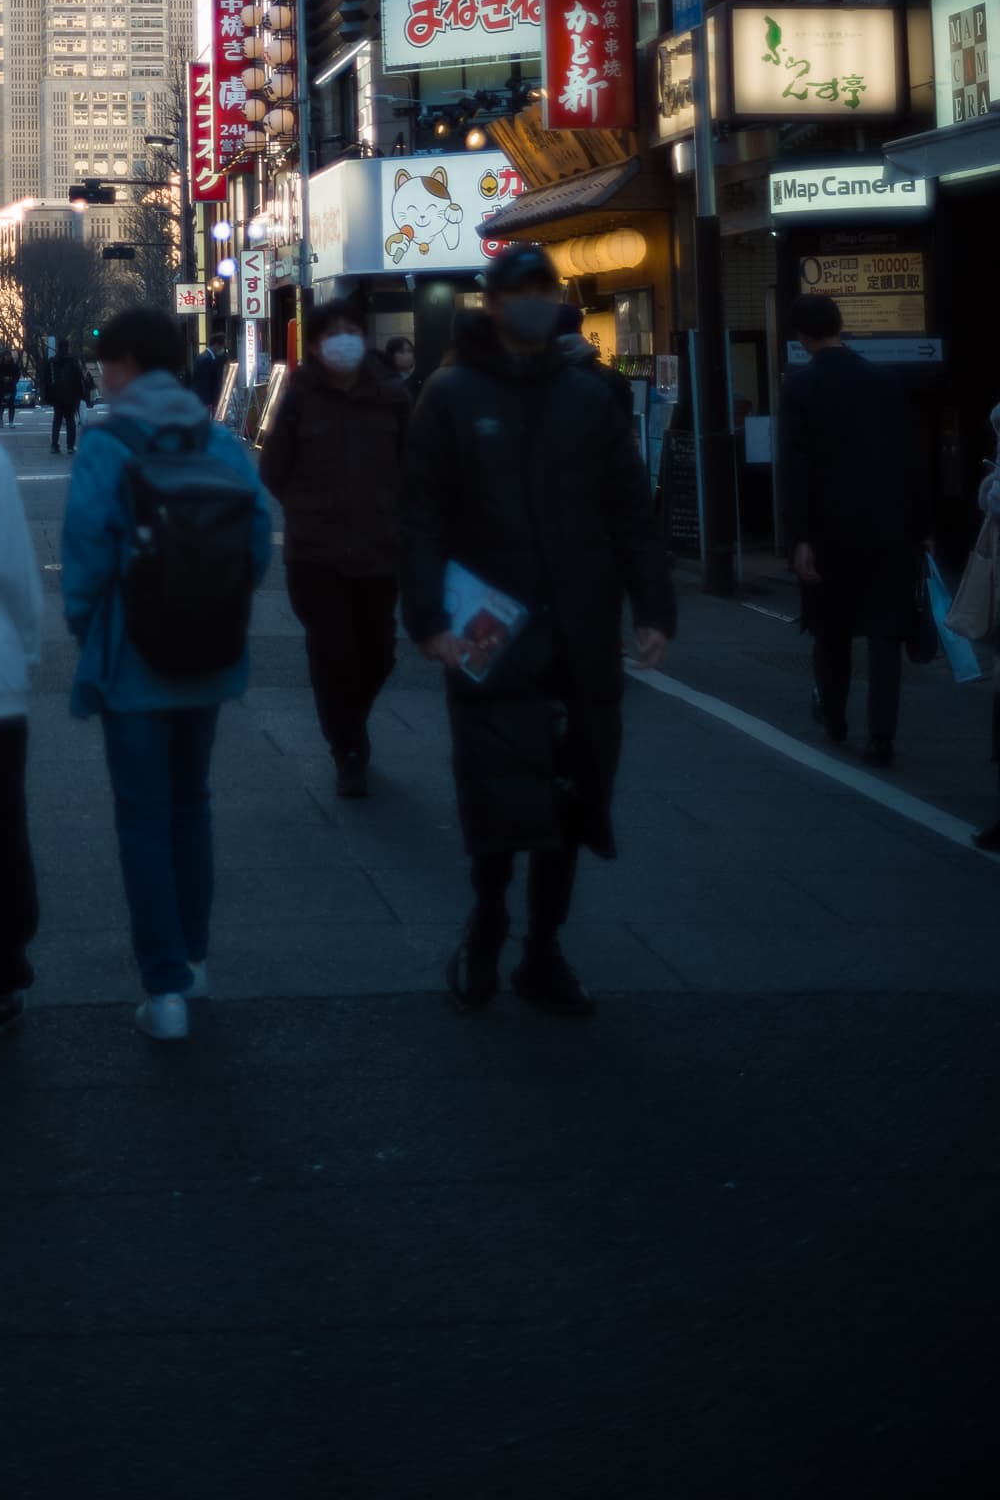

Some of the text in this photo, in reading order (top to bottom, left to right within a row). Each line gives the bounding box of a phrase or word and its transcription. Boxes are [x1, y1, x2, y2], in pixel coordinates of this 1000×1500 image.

[557, 1, 609, 124] かど新
[220, 125, 248, 136] 24H
[784, 178, 819, 202] Map
[244, 254, 261, 315] くすり
